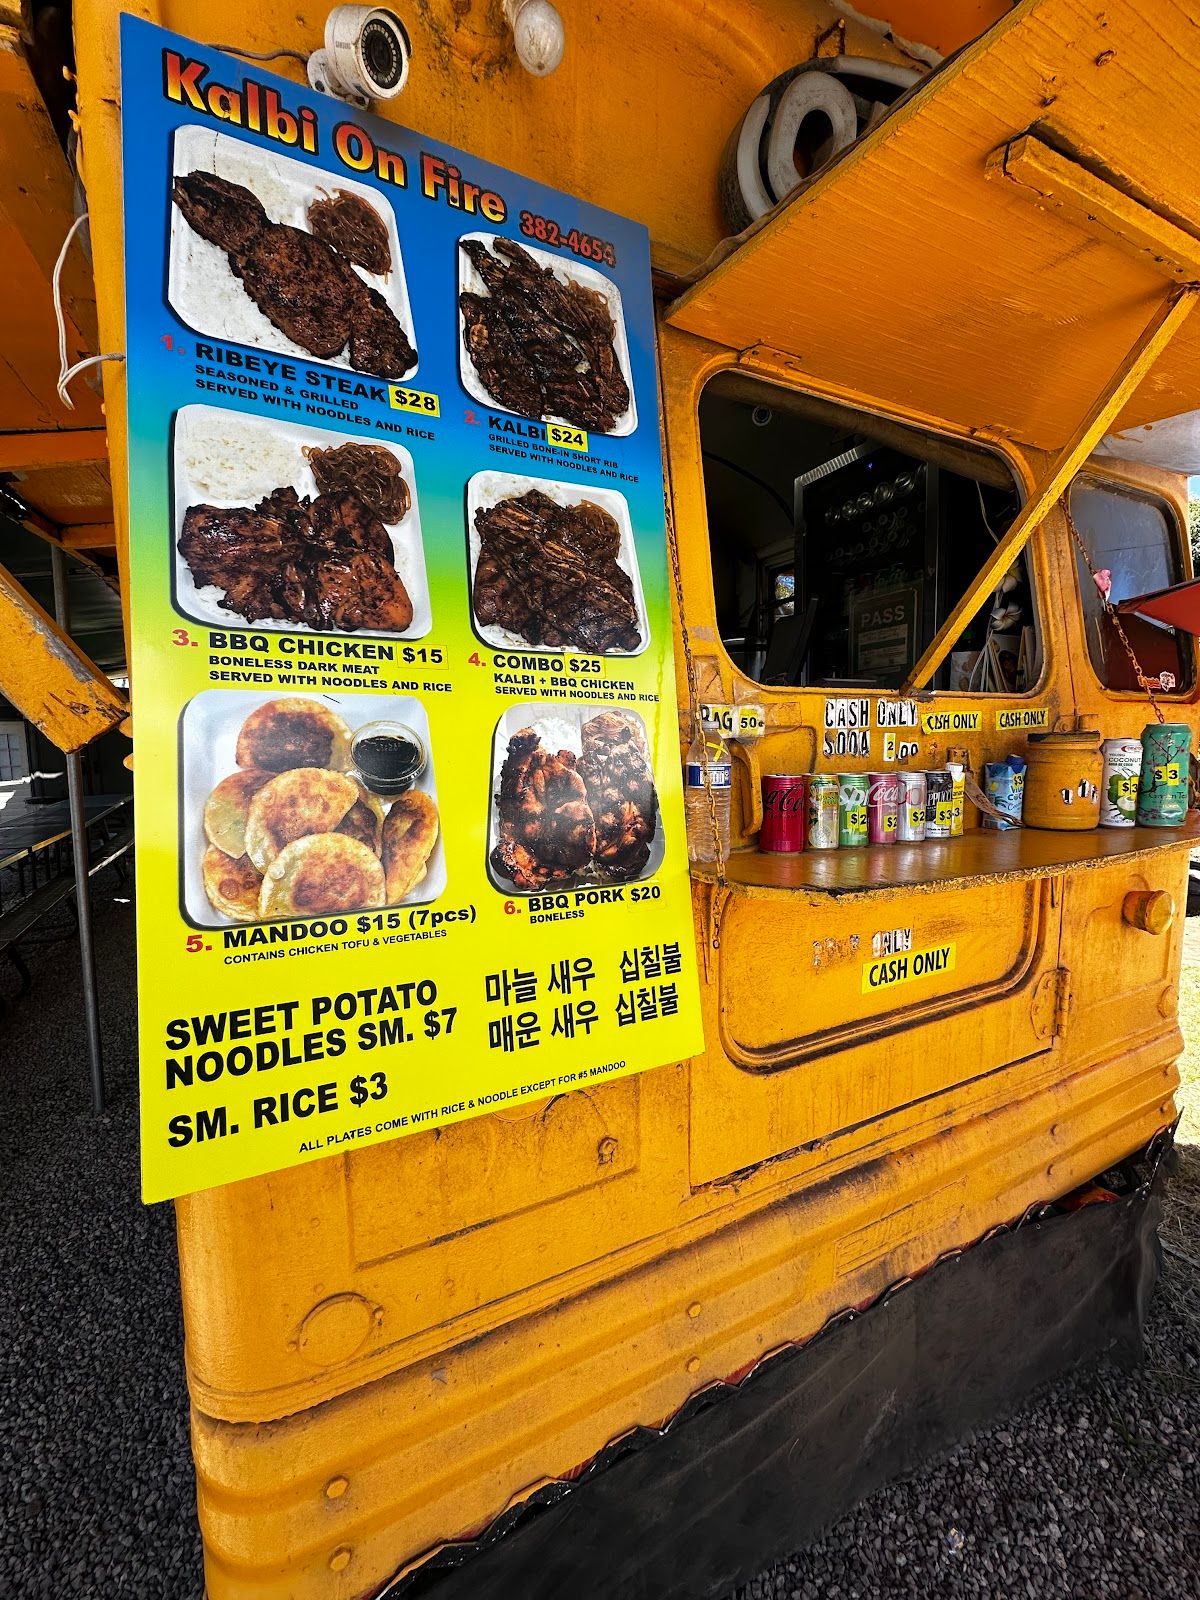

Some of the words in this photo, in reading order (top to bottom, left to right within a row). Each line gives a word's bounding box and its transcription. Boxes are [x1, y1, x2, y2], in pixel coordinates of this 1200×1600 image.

[163, 49, 318, 155] Kalbi
[333, 121, 408, 188] On
[420, 151, 506, 223] Fire
[160, 335, 185, 354] 1.
[196, 342, 296, 382] RIBEYE
[305, 371, 385, 402] STEAK
[395, 389, 436, 411] $28
[195, 364, 280, 393] SEASONED
[285, 385, 294, 396] &
[299, 388, 359, 410] GRILLED
[195, 379, 259, 403] SERVED
[262, 394, 301, 410] WITH
[306, 403, 371, 426] NOODLES
[375, 419, 402, 433] AND
[406, 426, 435, 440] RICE
[464, 410, 481, 426] 2.
[488, 415, 546, 441] KALBI
[552, 428, 584, 446] $24
[489, 434, 530, 449] GRILLED
[532, 442, 570, 459] BONE-IN
[572, 451, 601, 465] SHORT
[603, 459, 618, 468] RIB
[489, 445, 527, 460] SERVED
[530, 452, 554, 466] WITH
[556, 457, 598, 475] NOODLES
[600, 467, 618, 479] AND
[619, 472, 639, 483] RICE
[861, 605, 905, 627] PASS
[172, 629, 198, 647] 3.
[209, 632, 269, 653] BBQ
[278, 637, 394, 660] CHICKEN
[402, 646, 443, 664] $15
[468, 653, 487, 667] 4.
[493, 654, 564, 672] COMBO
[569, 658, 601, 673] $25
[209, 655, 292, 670] BONELESS
[297, 661, 337, 673] DARK
[342, 664, 379, 675] MEAT
[209, 670, 273, 683] SERVED
[278, 674, 317, 686] WITH
[321, 676, 388, 689] NOODLES
[392, 680, 419, 691] AND
[423, 682, 452, 692] RICE
[494, 673, 535, 685] KALBI
[550, 677, 577, 688] BBQ
[581, 679, 635, 691] CHICKEN
[495, 686, 537, 696] SERVED
[540, 687, 567, 698] WITH
[569, 690, 615, 700] NOODLES
[617, 692, 636, 702] AND
[639, 693, 660, 702] RICE
[825, 700, 868, 727] CASH
[878, 701, 915, 725] ONLY
[953, 714, 978, 729] ONLY
[1000, 712, 1020, 727] CASH
[1024, 711, 1045, 725] ONLY
[1013, 776, 1023, 786] $3
[1122, 782, 1138, 793] $3
[851, 814, 866, 825] $2
[912, 811, 925, 822] $2
[503, 901, 522, 915] 6.
[528, 894, 570, 912] BBQ
[575, 888, 625, 907] PORK
[631, 886, 661, 903] $20
[529, 909, 585, 924] BONELESS
[186, 935, 213, 953] 5.
[223, 919, 348, 949] MANDOO
[356, 913, 401, 935] $15
[408, 904, 477, 930] (7pcs)
[224, 949, 285, 965] CONTAINS
[288, 942, 339, 957] CHICKEN
[341, 937, 370, 950] TOFU
[372, 937, 381, 947] &
[382, 929, 447, 945] VEGETABLES
[485, 967, 538, 1007] 마늘
[547, 957, 596, 995] 새우
[619, 941, 682, 984] 십칠불
[869, 958, 908, 987] CASH
[913, 947, 950, 976] ONLY
[165, 1001, 300, 1051] SWEET
[312, 979, 438, 1025] POTATO
[488, 1011, 541, 1053] 매운
[550, 1000, 599, 1039] 새우
[615, 982, 679, 1028] 십칠불
[165, 1028, 347, 1090] NOODLES
[358, 1017, 414, 1051] SM.
[424, 1007, 458, 1041] $7
[167, 1106, 240, 1148] SM.
[253, 1082, 339, 1129] RICE
[349, 1072, 389, 1108] $3
[299, 1138, 324, 1154] ALL
[326, 1127, 372, 1145] PLATES
[375, 1116, 409, 1133] COME
[411, 1109, 438, 1124] WITH
[441, 1102, 465, 1116] RICE
[468, 1099, 475, 1108] &
[478, 1088, 519, 1107] NOODLE
[521, 1079, 557, 1095] EXCEPT
[558, 1073, 577, 1085] FOR
[578, 1070, 588, 1080] #5
[590, 1060, 626, 1077] MANDOO
